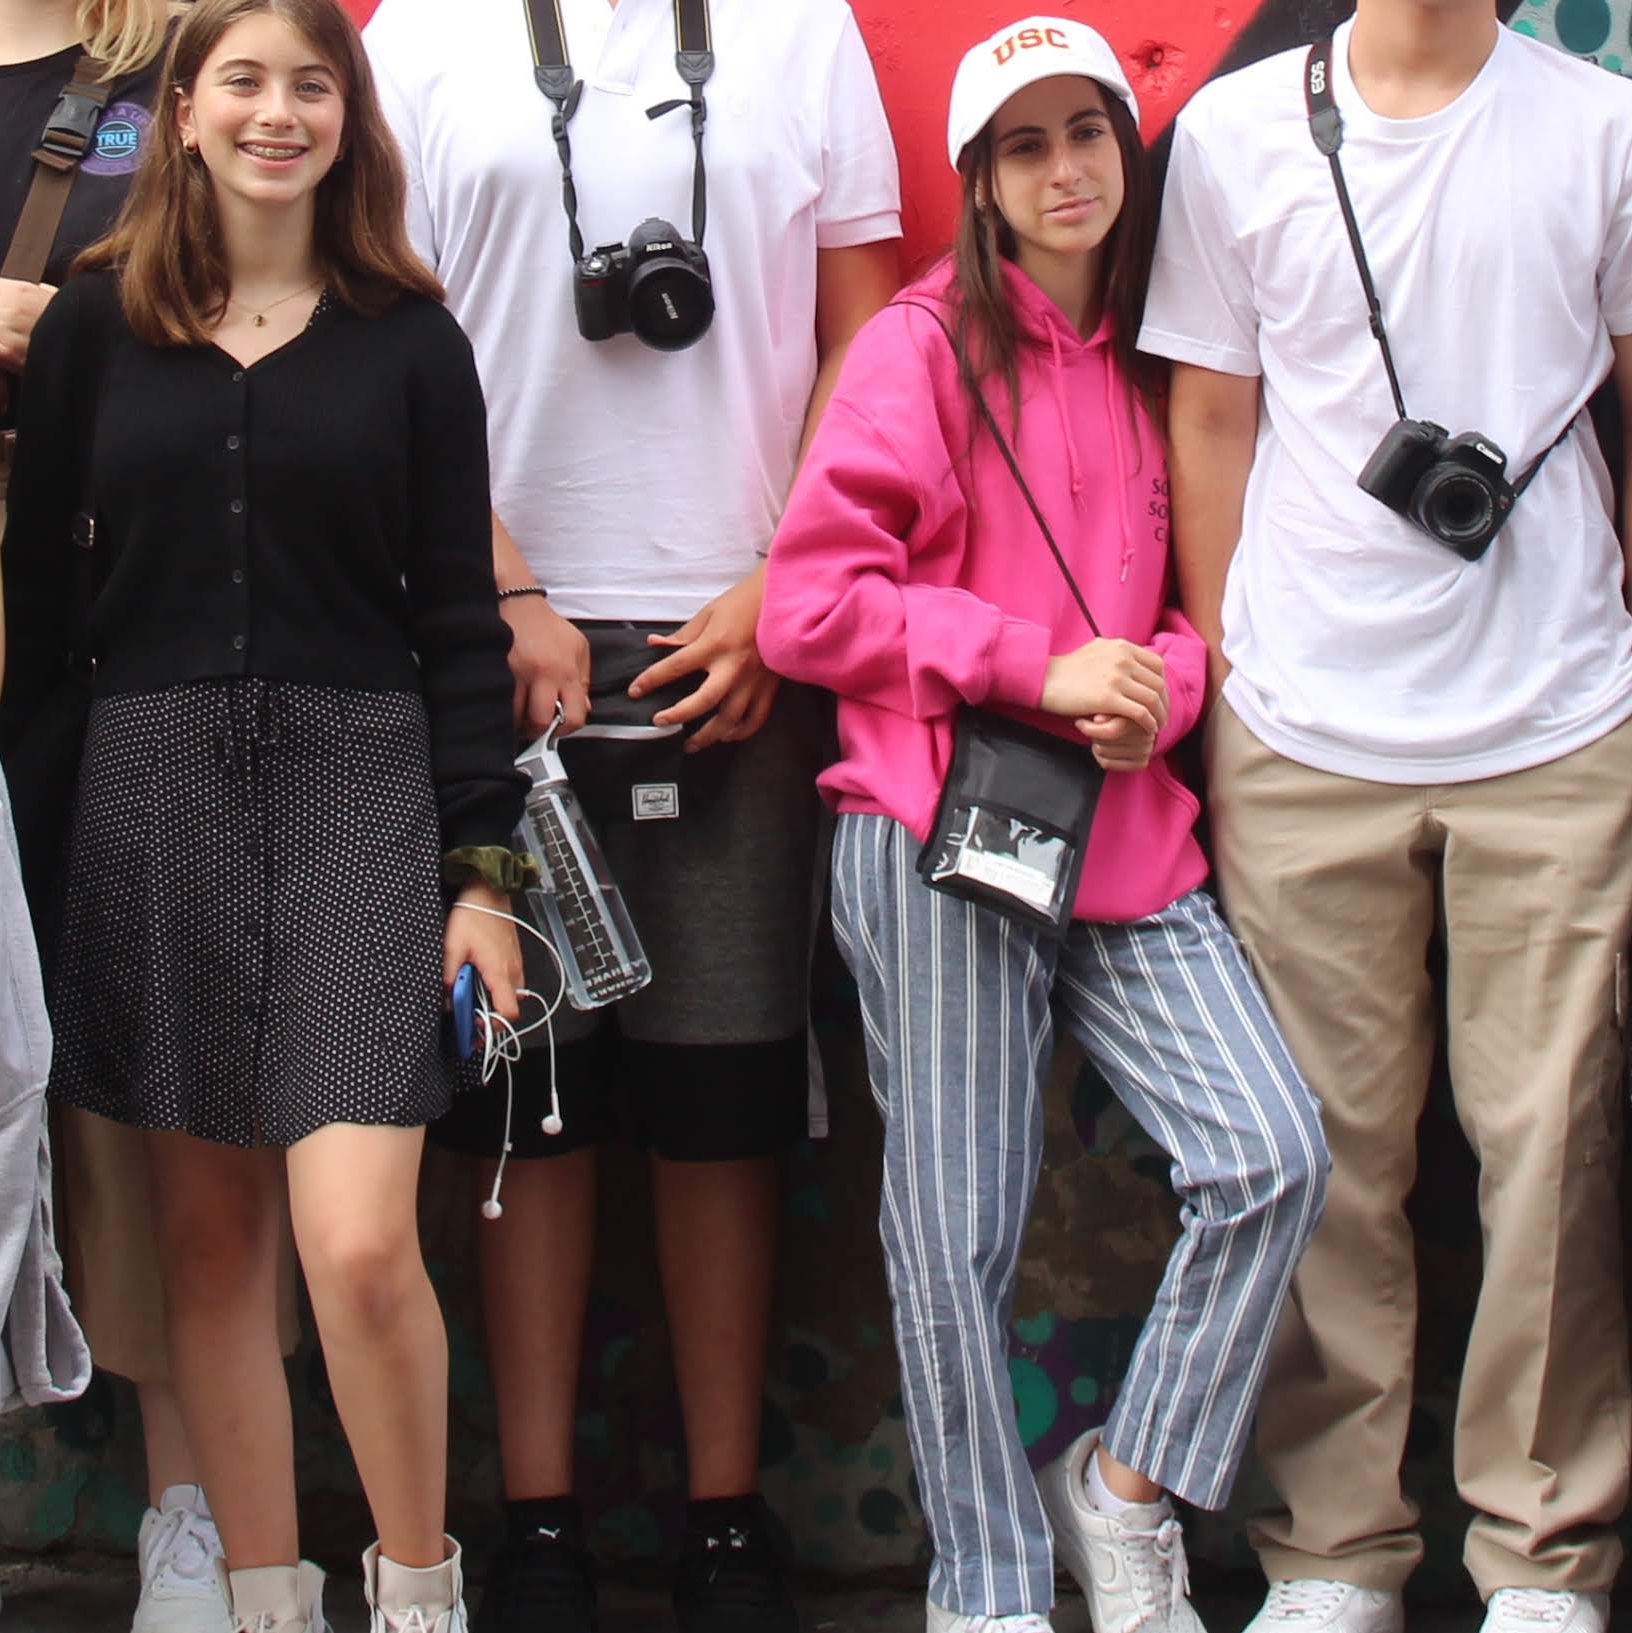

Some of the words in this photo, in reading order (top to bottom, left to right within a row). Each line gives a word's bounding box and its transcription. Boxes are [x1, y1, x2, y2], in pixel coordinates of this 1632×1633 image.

[992, 27, 1070, 66] USC
[1310, 60, 1326, 95] EOS
[96, 132, 137, 146] TRUE
